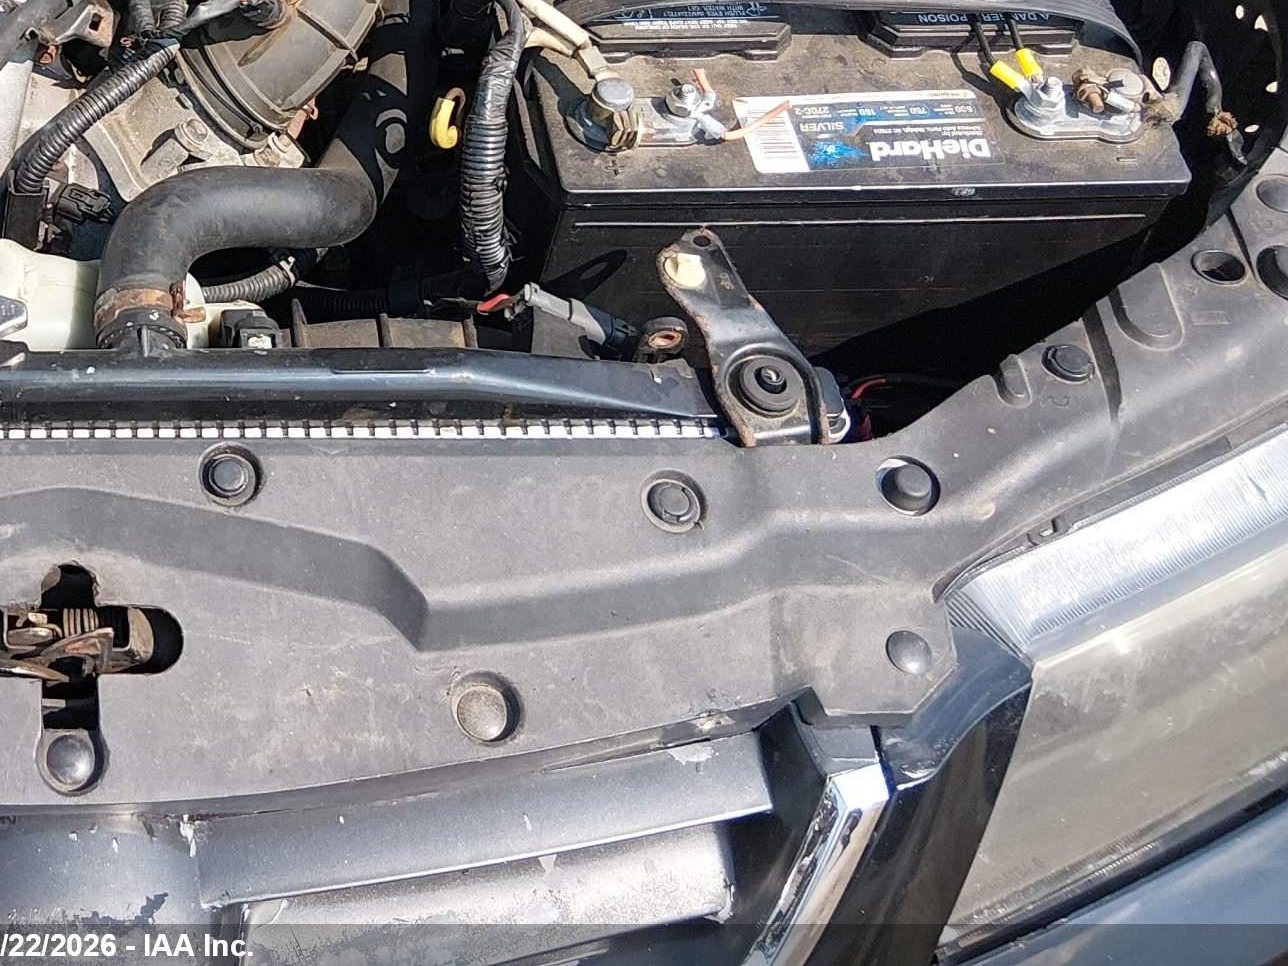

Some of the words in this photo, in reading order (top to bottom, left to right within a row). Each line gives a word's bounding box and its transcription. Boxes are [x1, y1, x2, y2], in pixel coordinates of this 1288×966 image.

[917, 13, 968, 23] POISON
[799, 121, 845, 132] SILVER
[869, 138, 992, 161] DieHard
